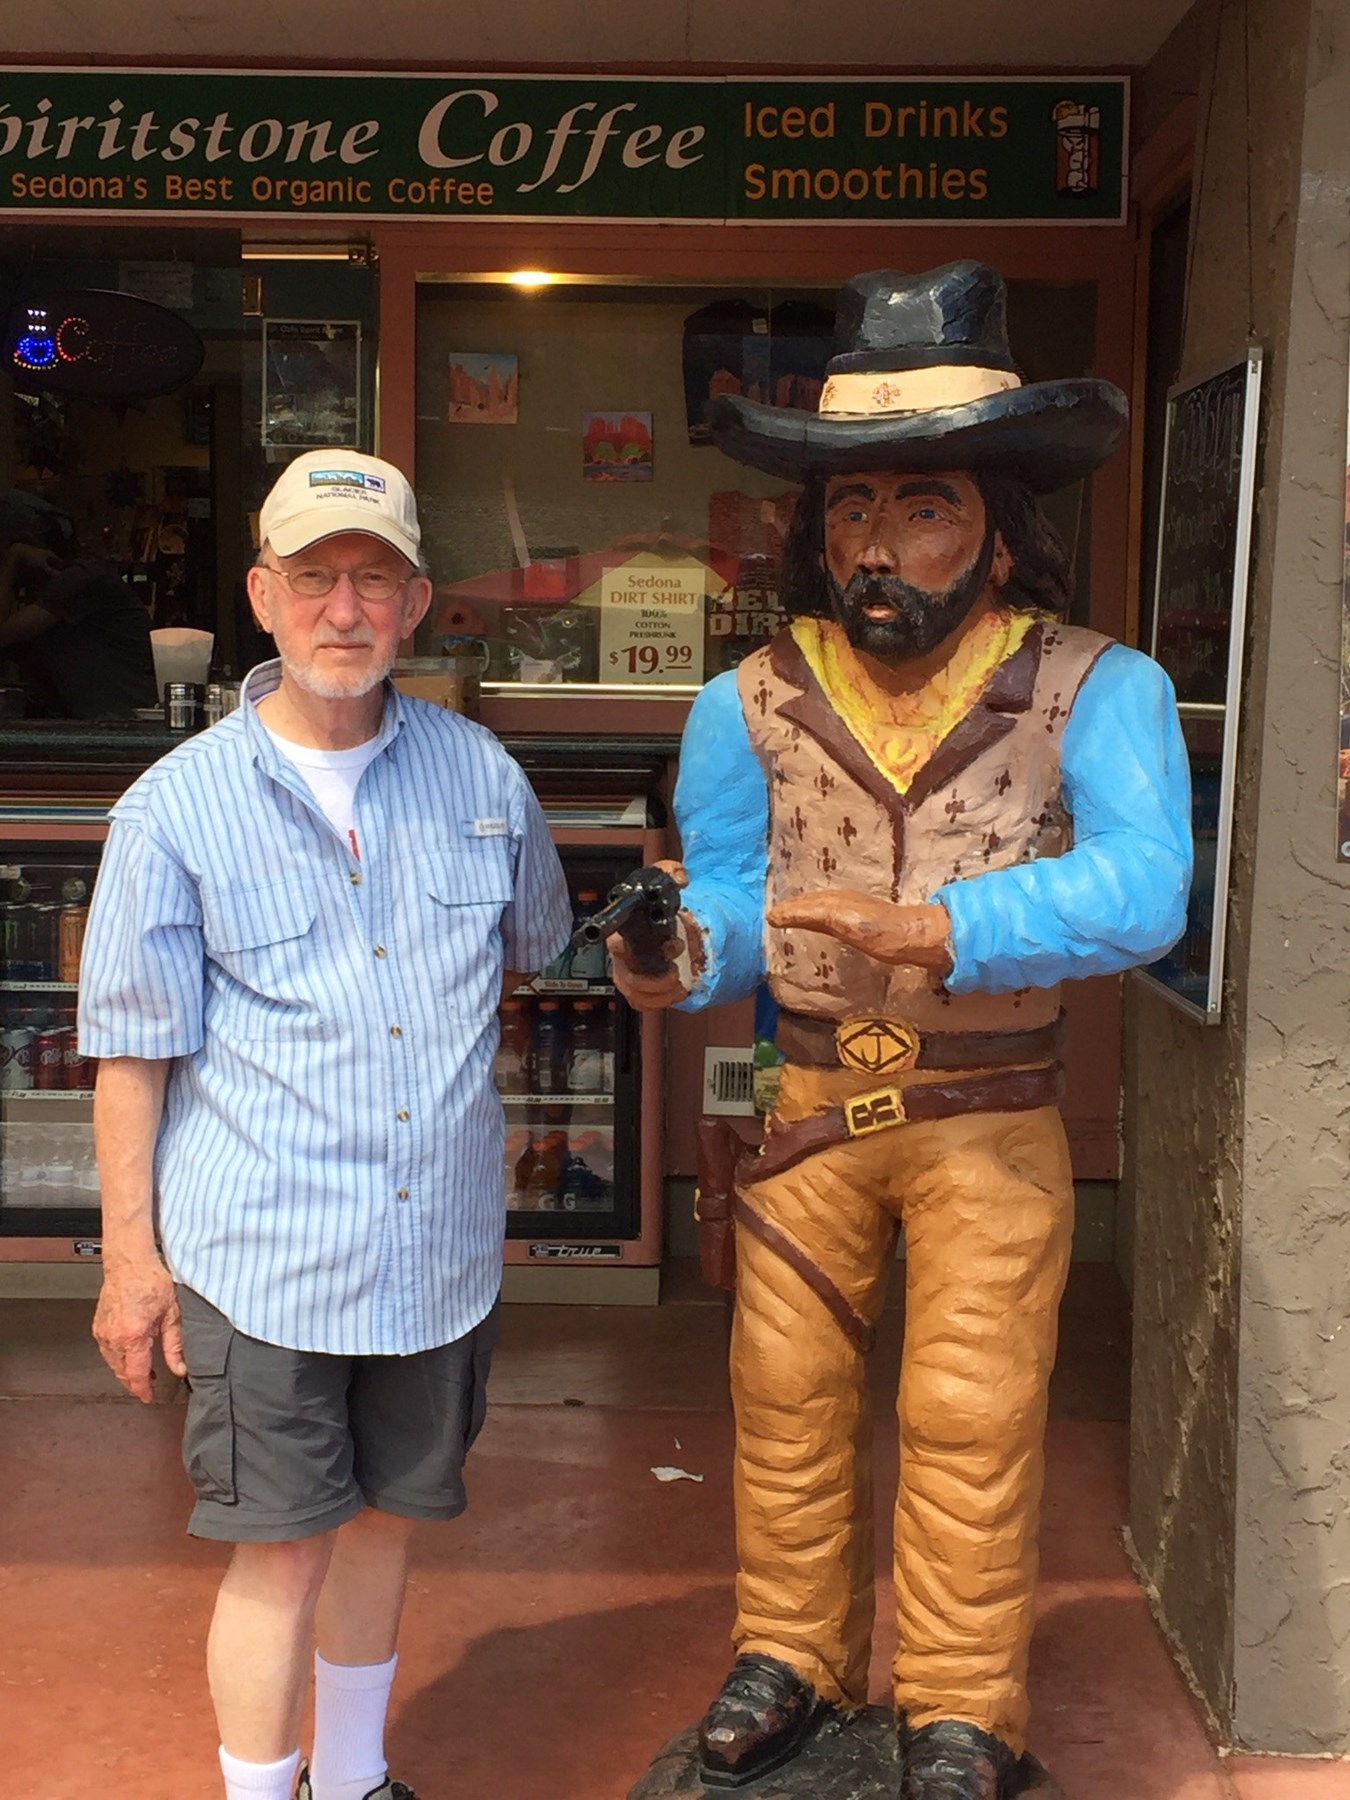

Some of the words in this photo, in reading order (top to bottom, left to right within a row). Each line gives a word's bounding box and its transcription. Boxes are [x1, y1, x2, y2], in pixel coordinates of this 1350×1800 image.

[743, 101, 835, 138] Iced
[864, 100, 1009, 138] Drinks
[417, 88, 705, 194] Coffee
[743, 162, 988, 201] Smoothies
[11, 172, 148, 200] Sedona's
[165, 174, 234, 200] Best
[251, 176, 372, 206] Organic
[387, 178, 494, 206] Coffee
[316, 492, 356, 500] NATIONAL
[628, 575, 682, 588] Sedona
[610, 591, 647, 604] DIRT
[652, 592, 696, 605] SHIRT
[641, 609, 668, 618] 100%
[635, 621, 671, 629] COTTON
[709, 612, 788, 636] DIR
[629, 631, 677, 639] PRESHRUNK
